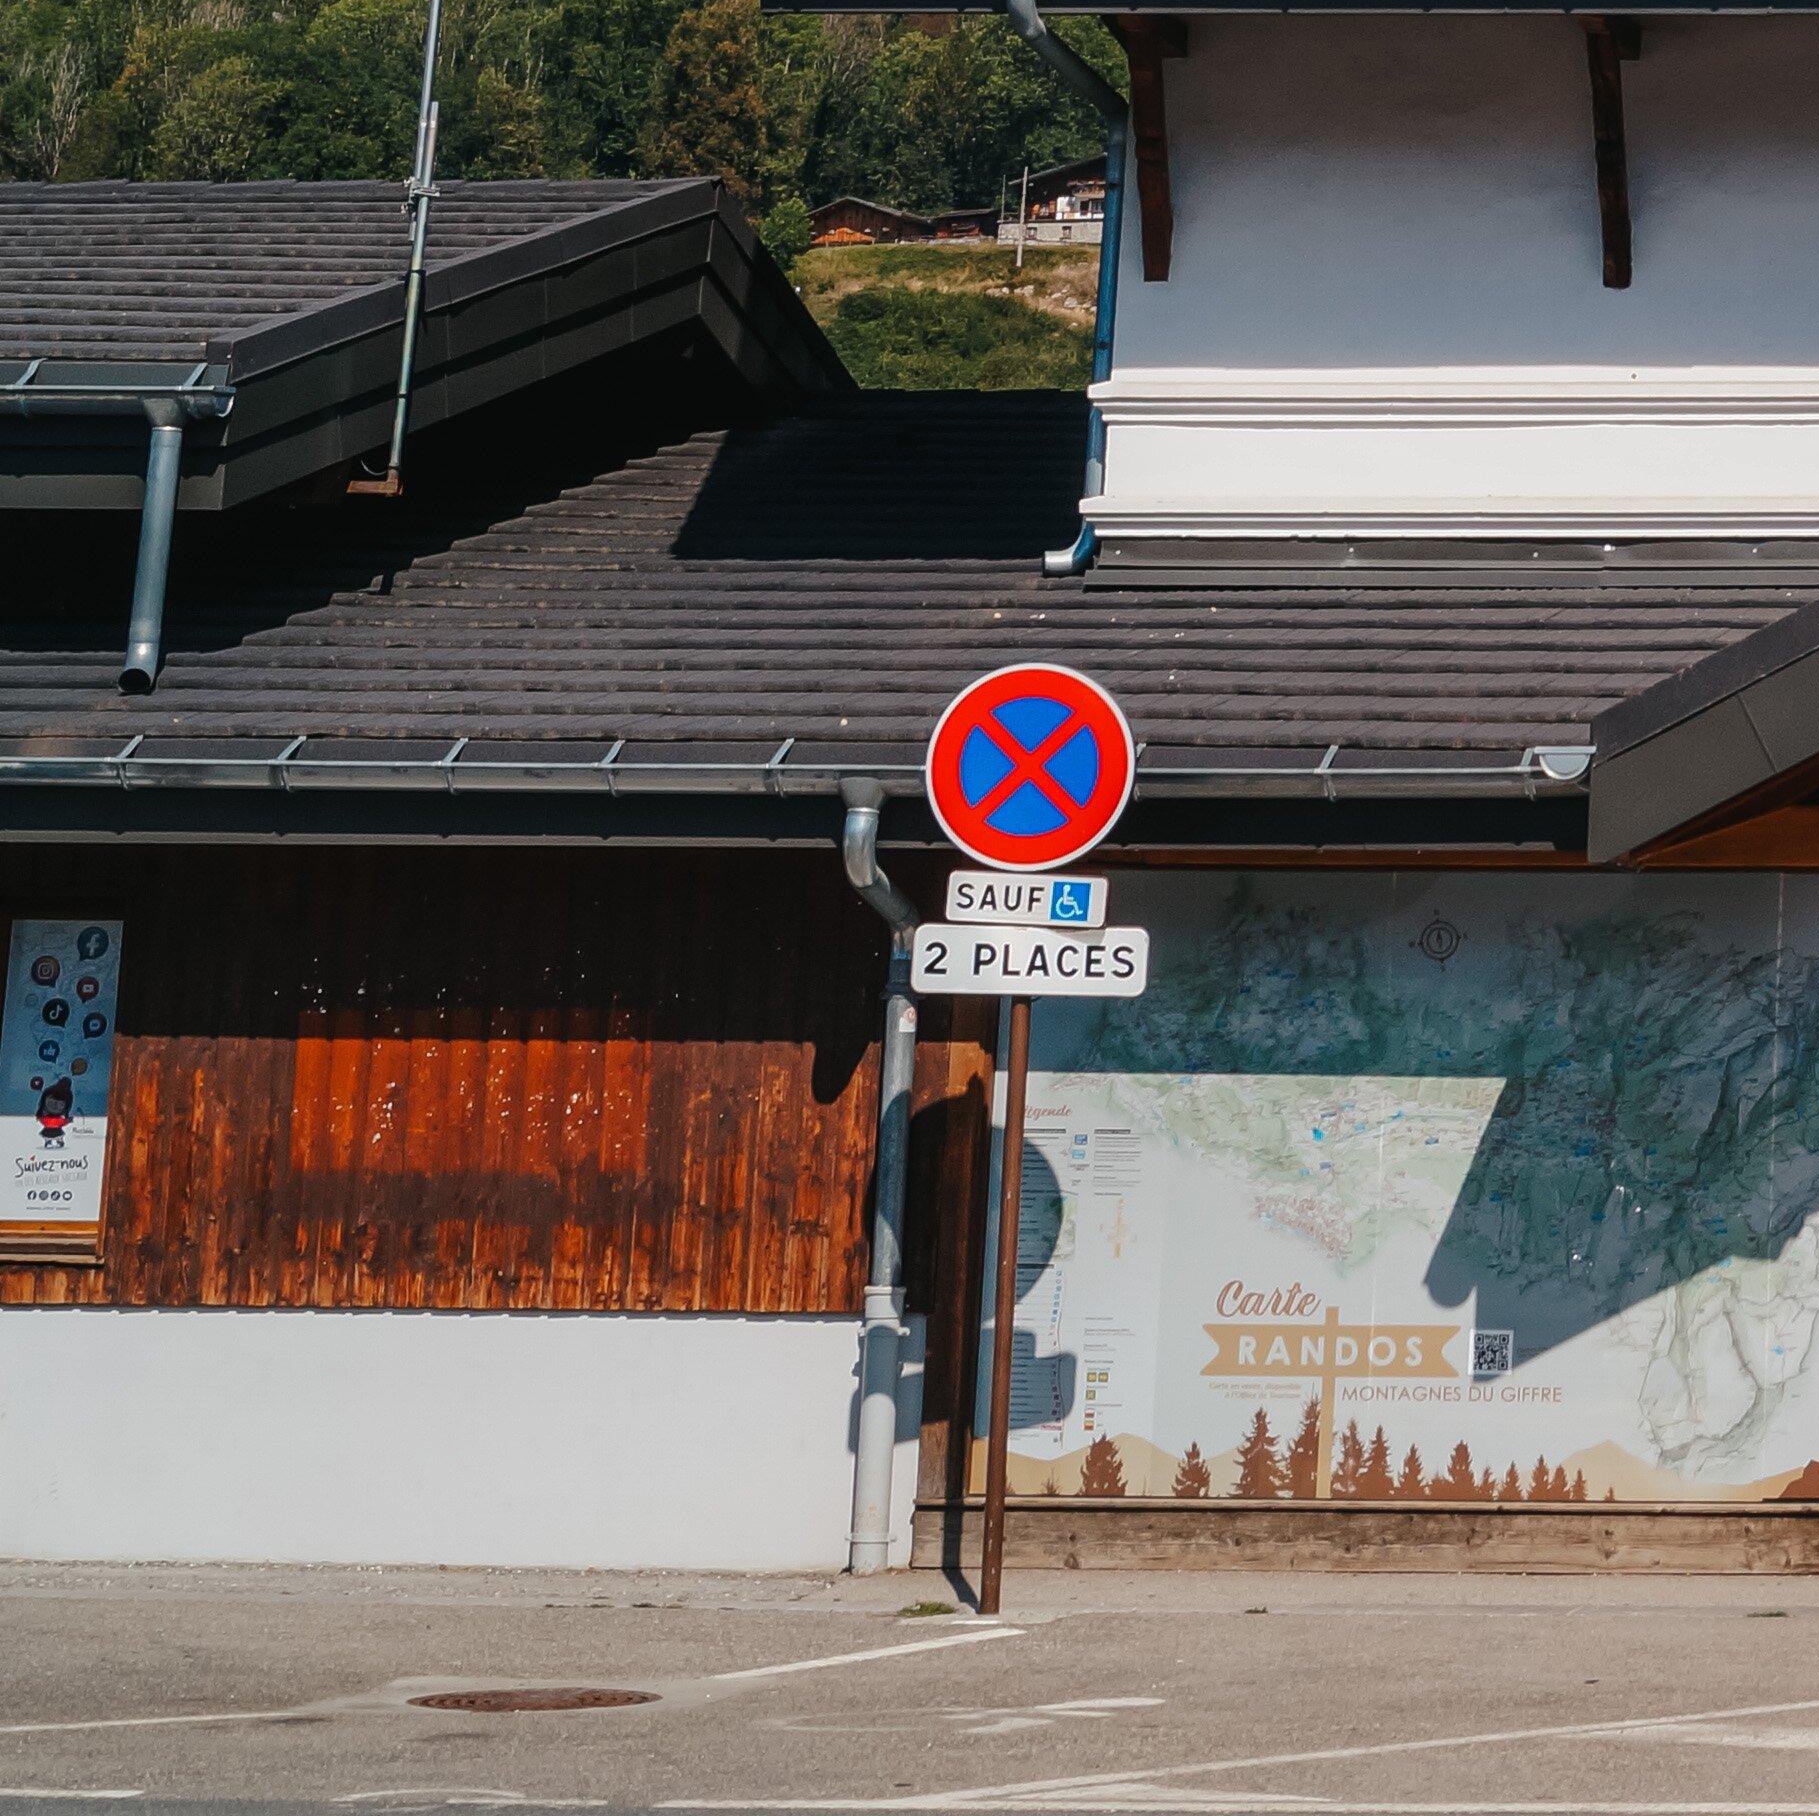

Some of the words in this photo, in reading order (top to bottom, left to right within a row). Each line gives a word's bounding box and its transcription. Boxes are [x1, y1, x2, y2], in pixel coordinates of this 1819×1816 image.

[956, 883, 1045, 912] SAUF
[924, 942, 948, 974] 2
[973, 943, 1135, 978] PLACES
[14, 1154, 89, 1179] Suivez-nous
[1215, 1280, 1322, 1318] Carte
[1238, 1335, 1424, 1367] RANDOS
[1341, 1386, 1462, 1403] MONTAGNES
[1468, 1386, 1494, 1402] DU
[1501, 1386, 1563, 1403] GIFFRE
